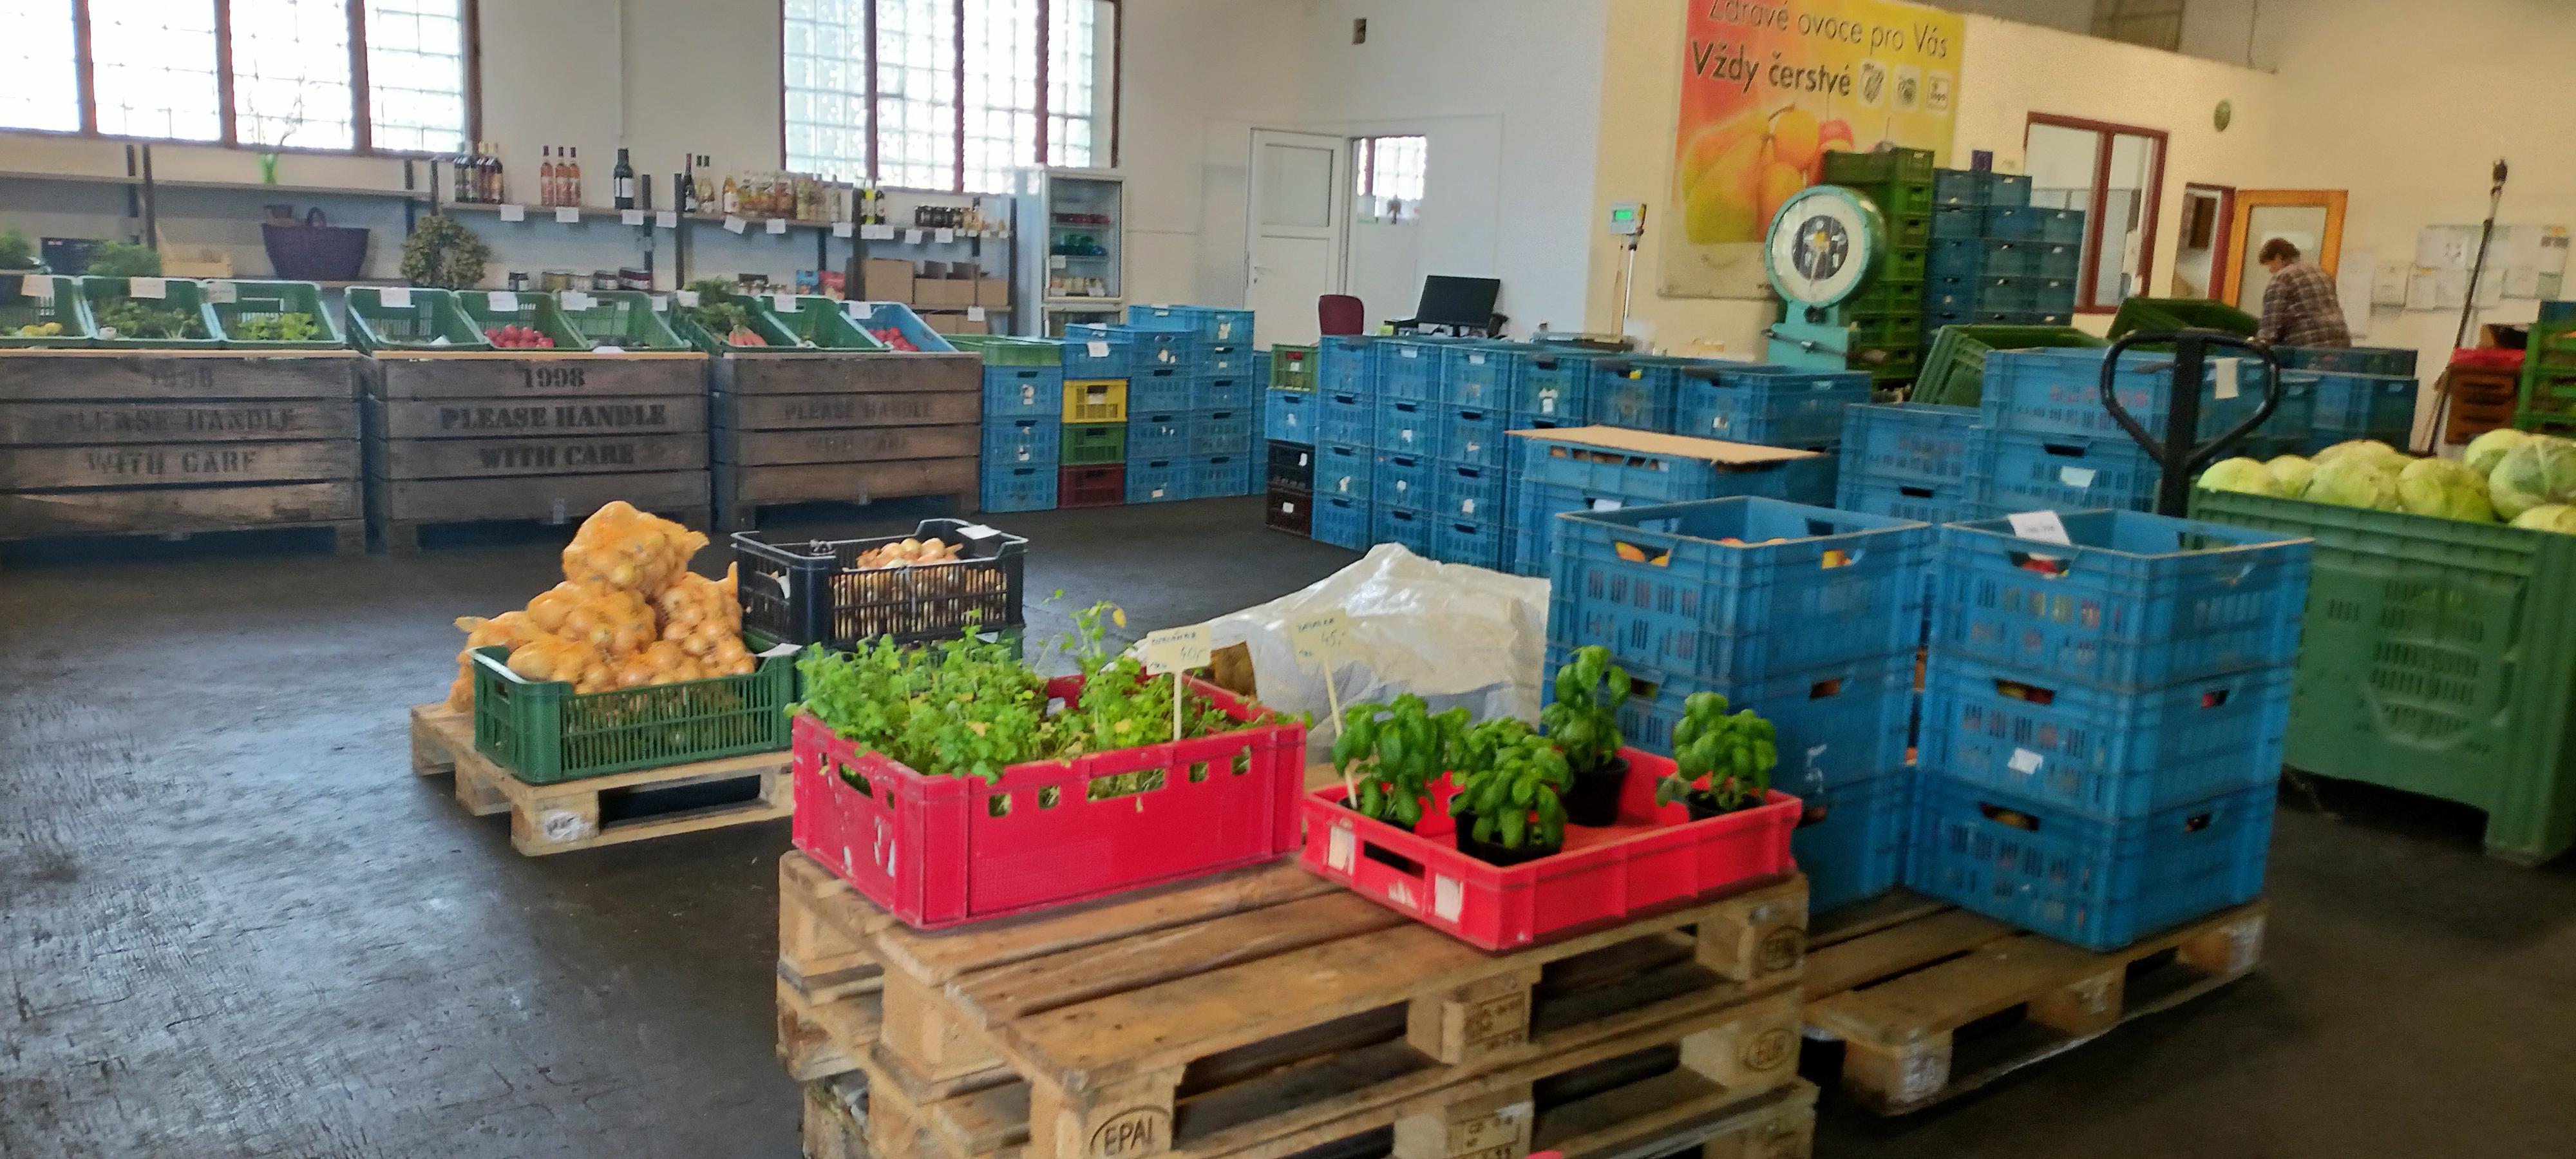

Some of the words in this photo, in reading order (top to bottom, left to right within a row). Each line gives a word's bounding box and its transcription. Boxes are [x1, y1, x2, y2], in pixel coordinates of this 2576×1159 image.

[1797, 13, 1862, 44] ovoce
[1870, 26, 1905, 55] pro
[1913, 21, 1949, 58] Vás
[1691, 40, 1760, 93] Vždy
[1768, 51, 1851, 97] čerstvé
[522, 367, 586, 388] 1998
[440, 407, 547, 429] PLEASE
[554, 404, 666, 427] HANDLE
[86, 451, 165, 474] WITH
[182, 451, 257, 473] CARE
[479, 445, 556, 469] WITH
[564, 444, 634, 466] CARE
